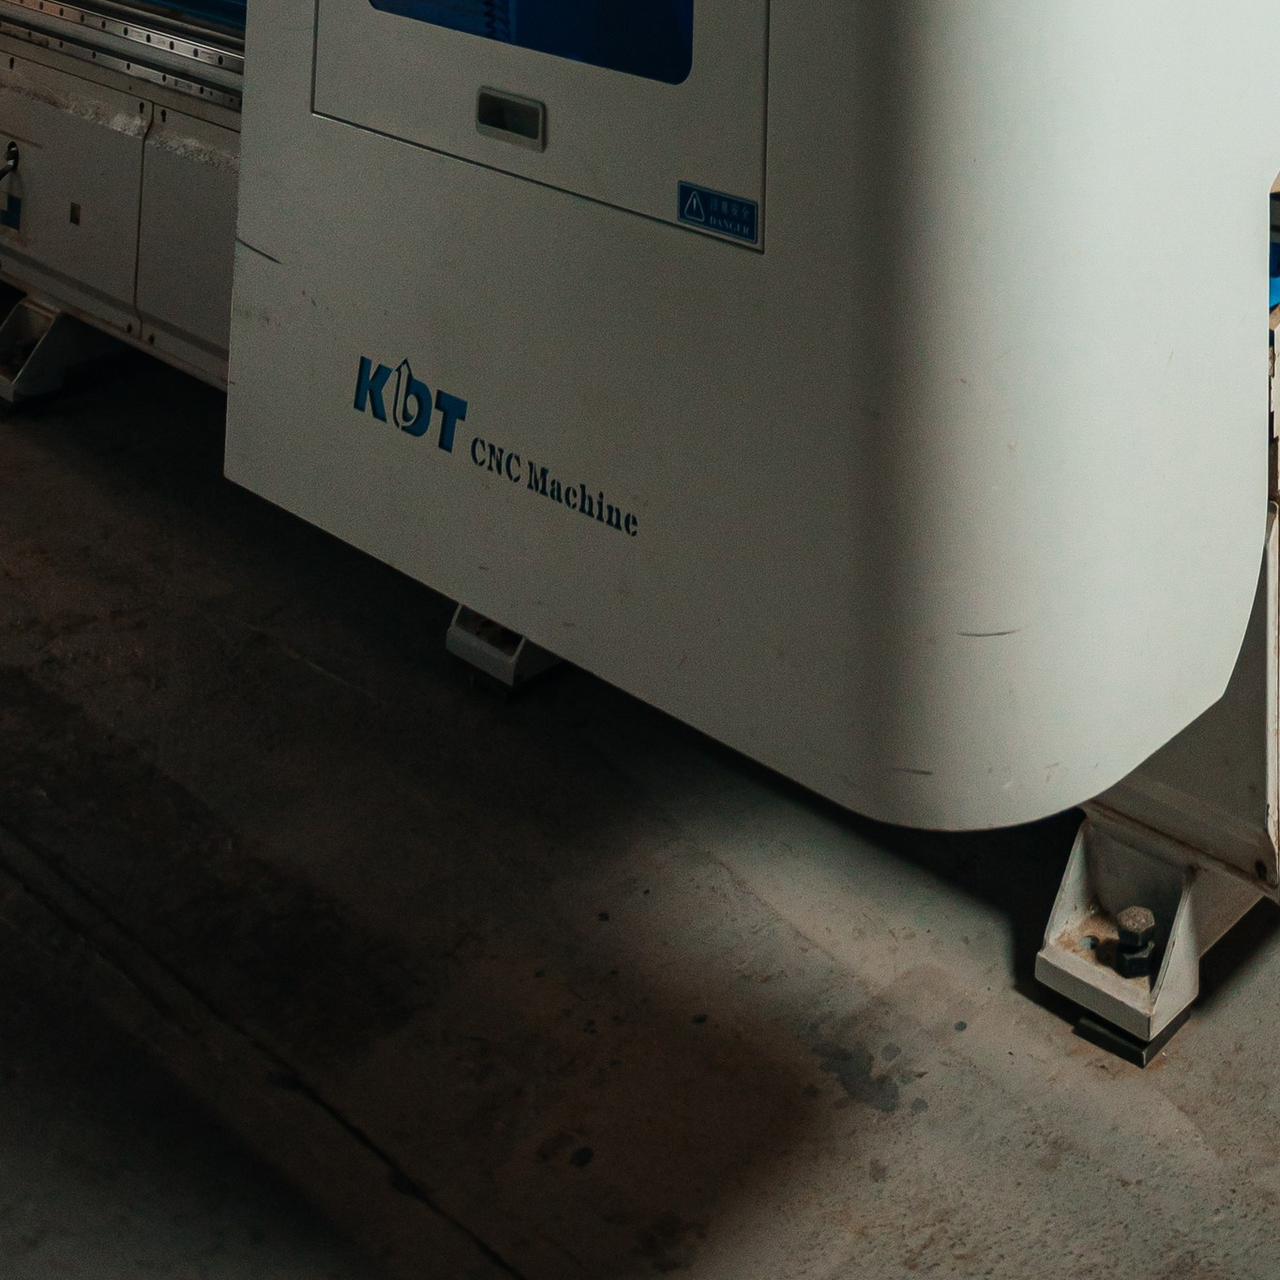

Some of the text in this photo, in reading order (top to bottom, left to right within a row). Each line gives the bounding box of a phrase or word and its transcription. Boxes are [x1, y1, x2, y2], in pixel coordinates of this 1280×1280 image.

[710, 215, 750, 236] DANGER
[353, 355, 638, 536] KDT CNC Machine
